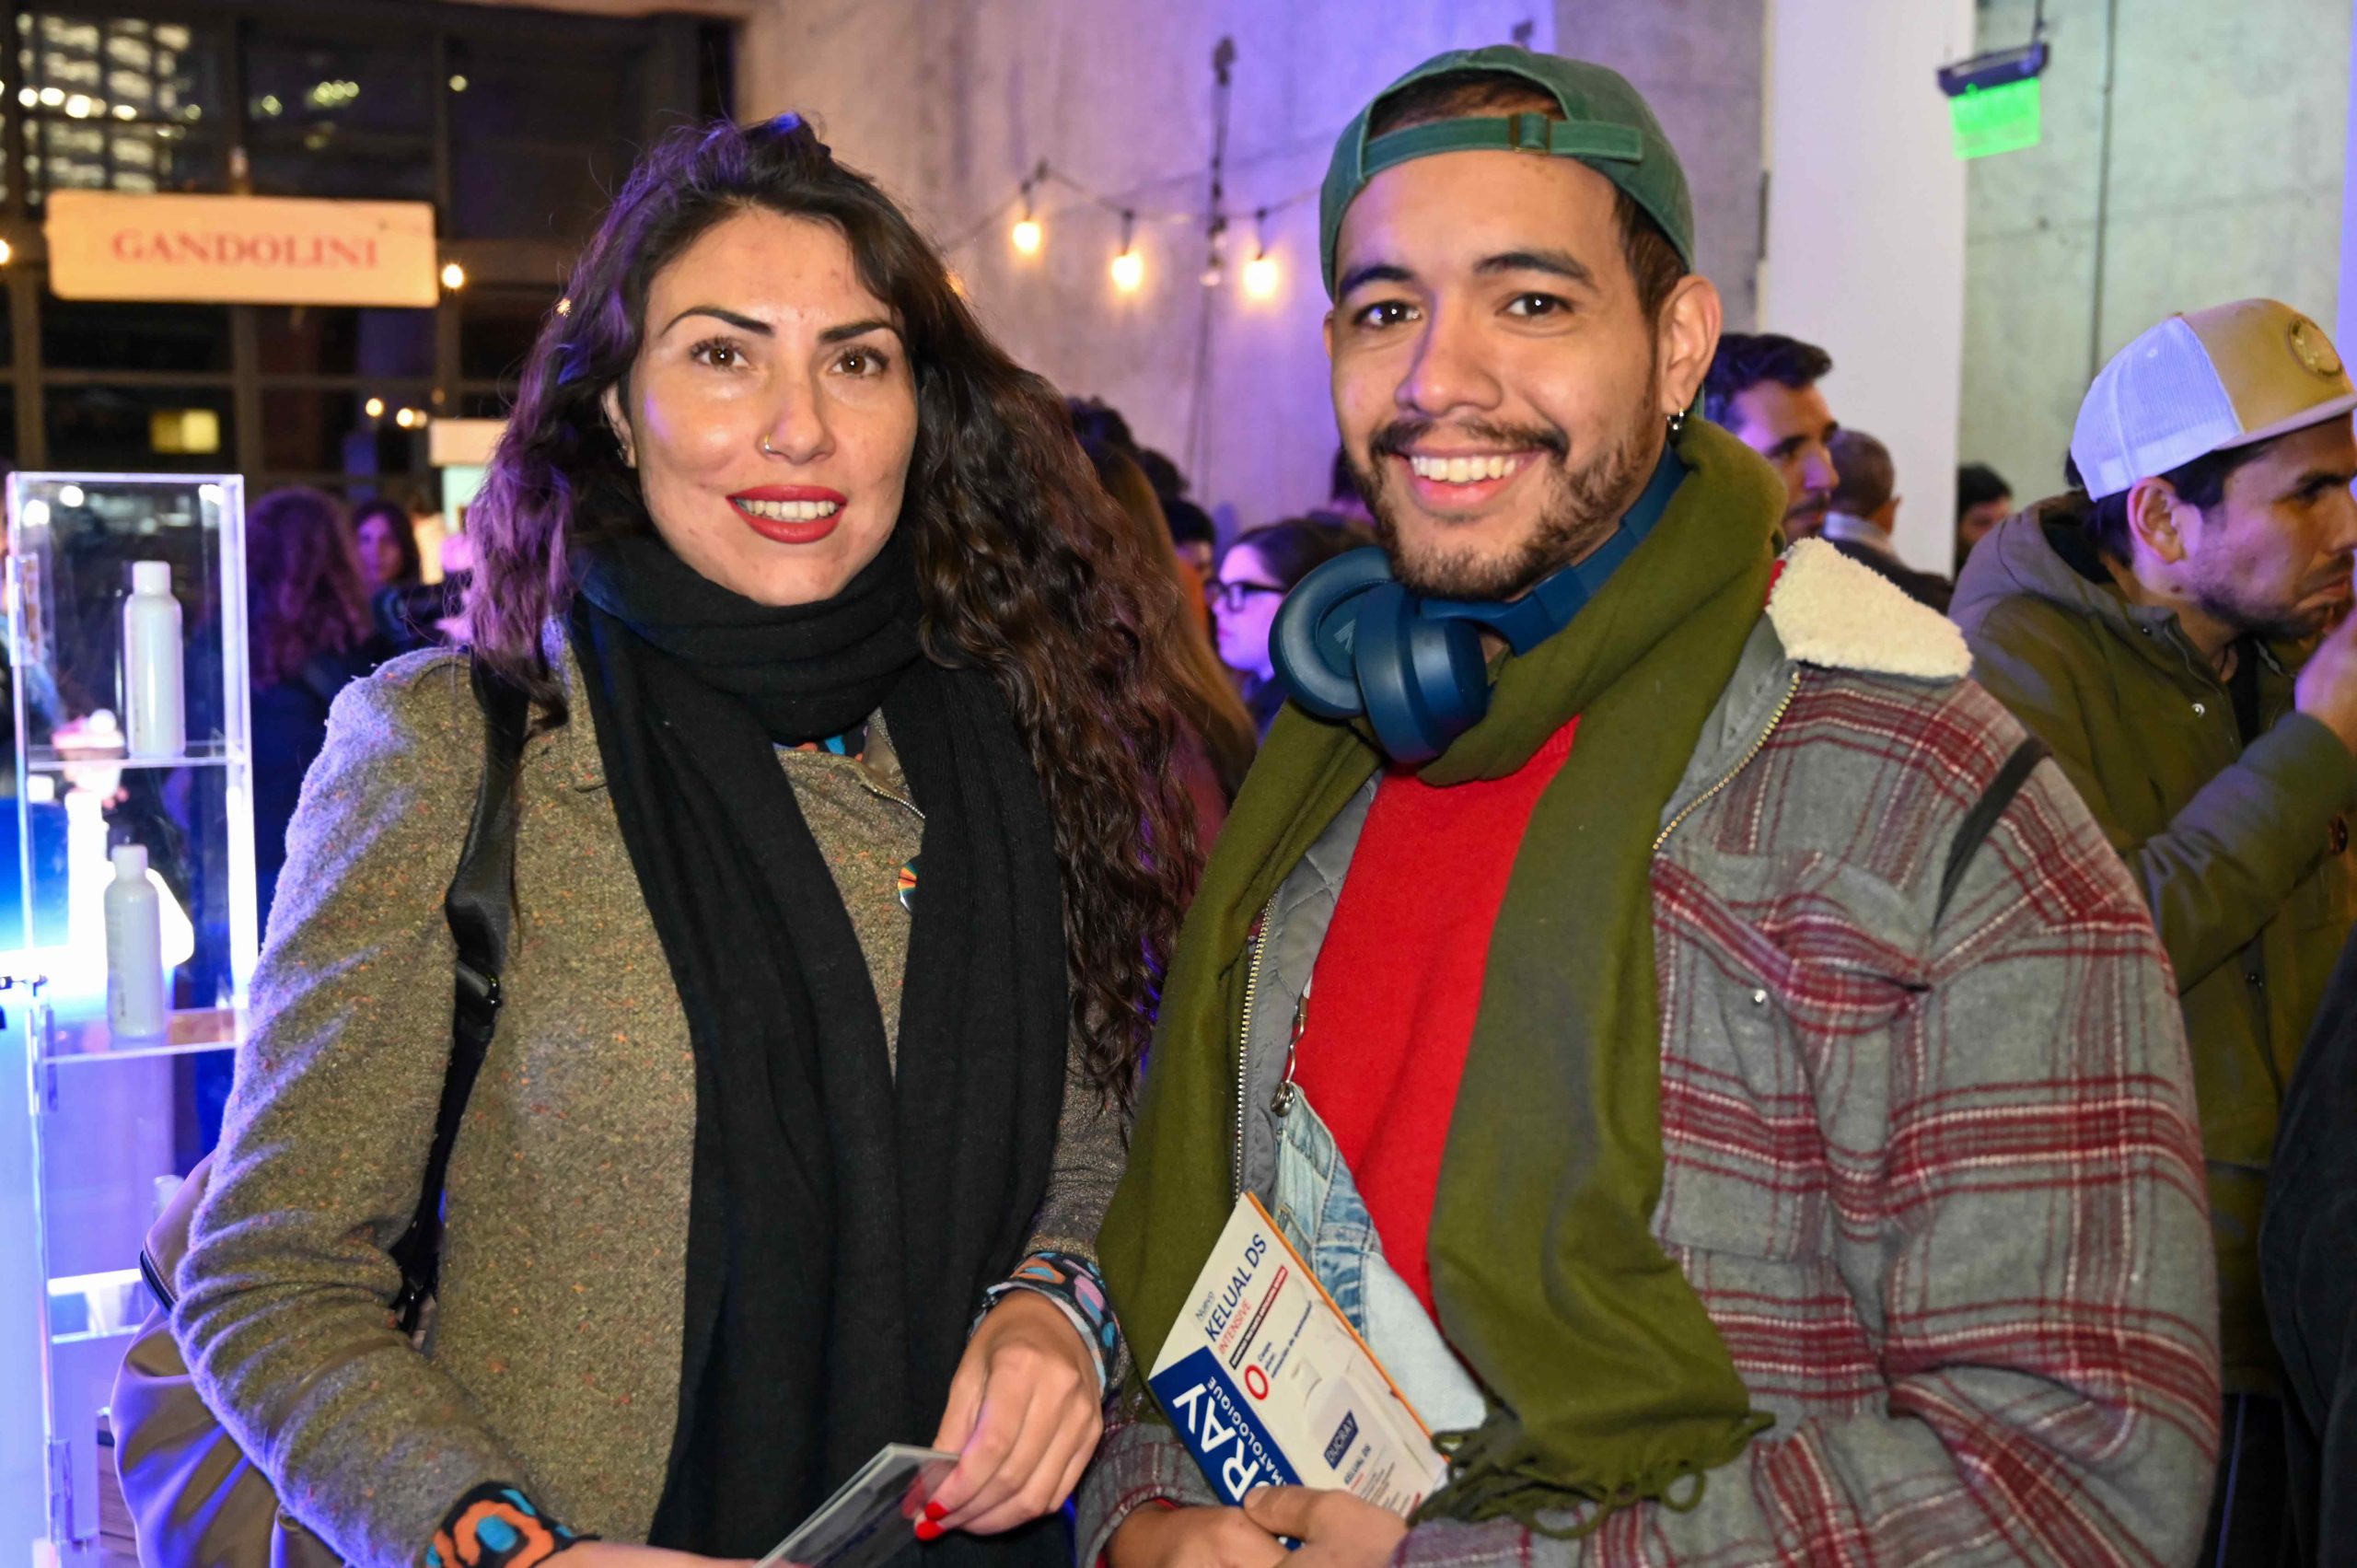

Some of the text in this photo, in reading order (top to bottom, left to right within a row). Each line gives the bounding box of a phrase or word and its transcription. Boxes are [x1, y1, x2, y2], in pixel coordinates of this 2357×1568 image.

[111, 227, 378, 270] GANDOLINI
[1204, 1233, 1267, 1342] KELUAL DS
[1218, 1297, 1252, 1354] INTENSIVE
[1172, 1383, 1270, 1502] RAY
[1207, 1376, 1287, 1486] MATOLOGIQUE
